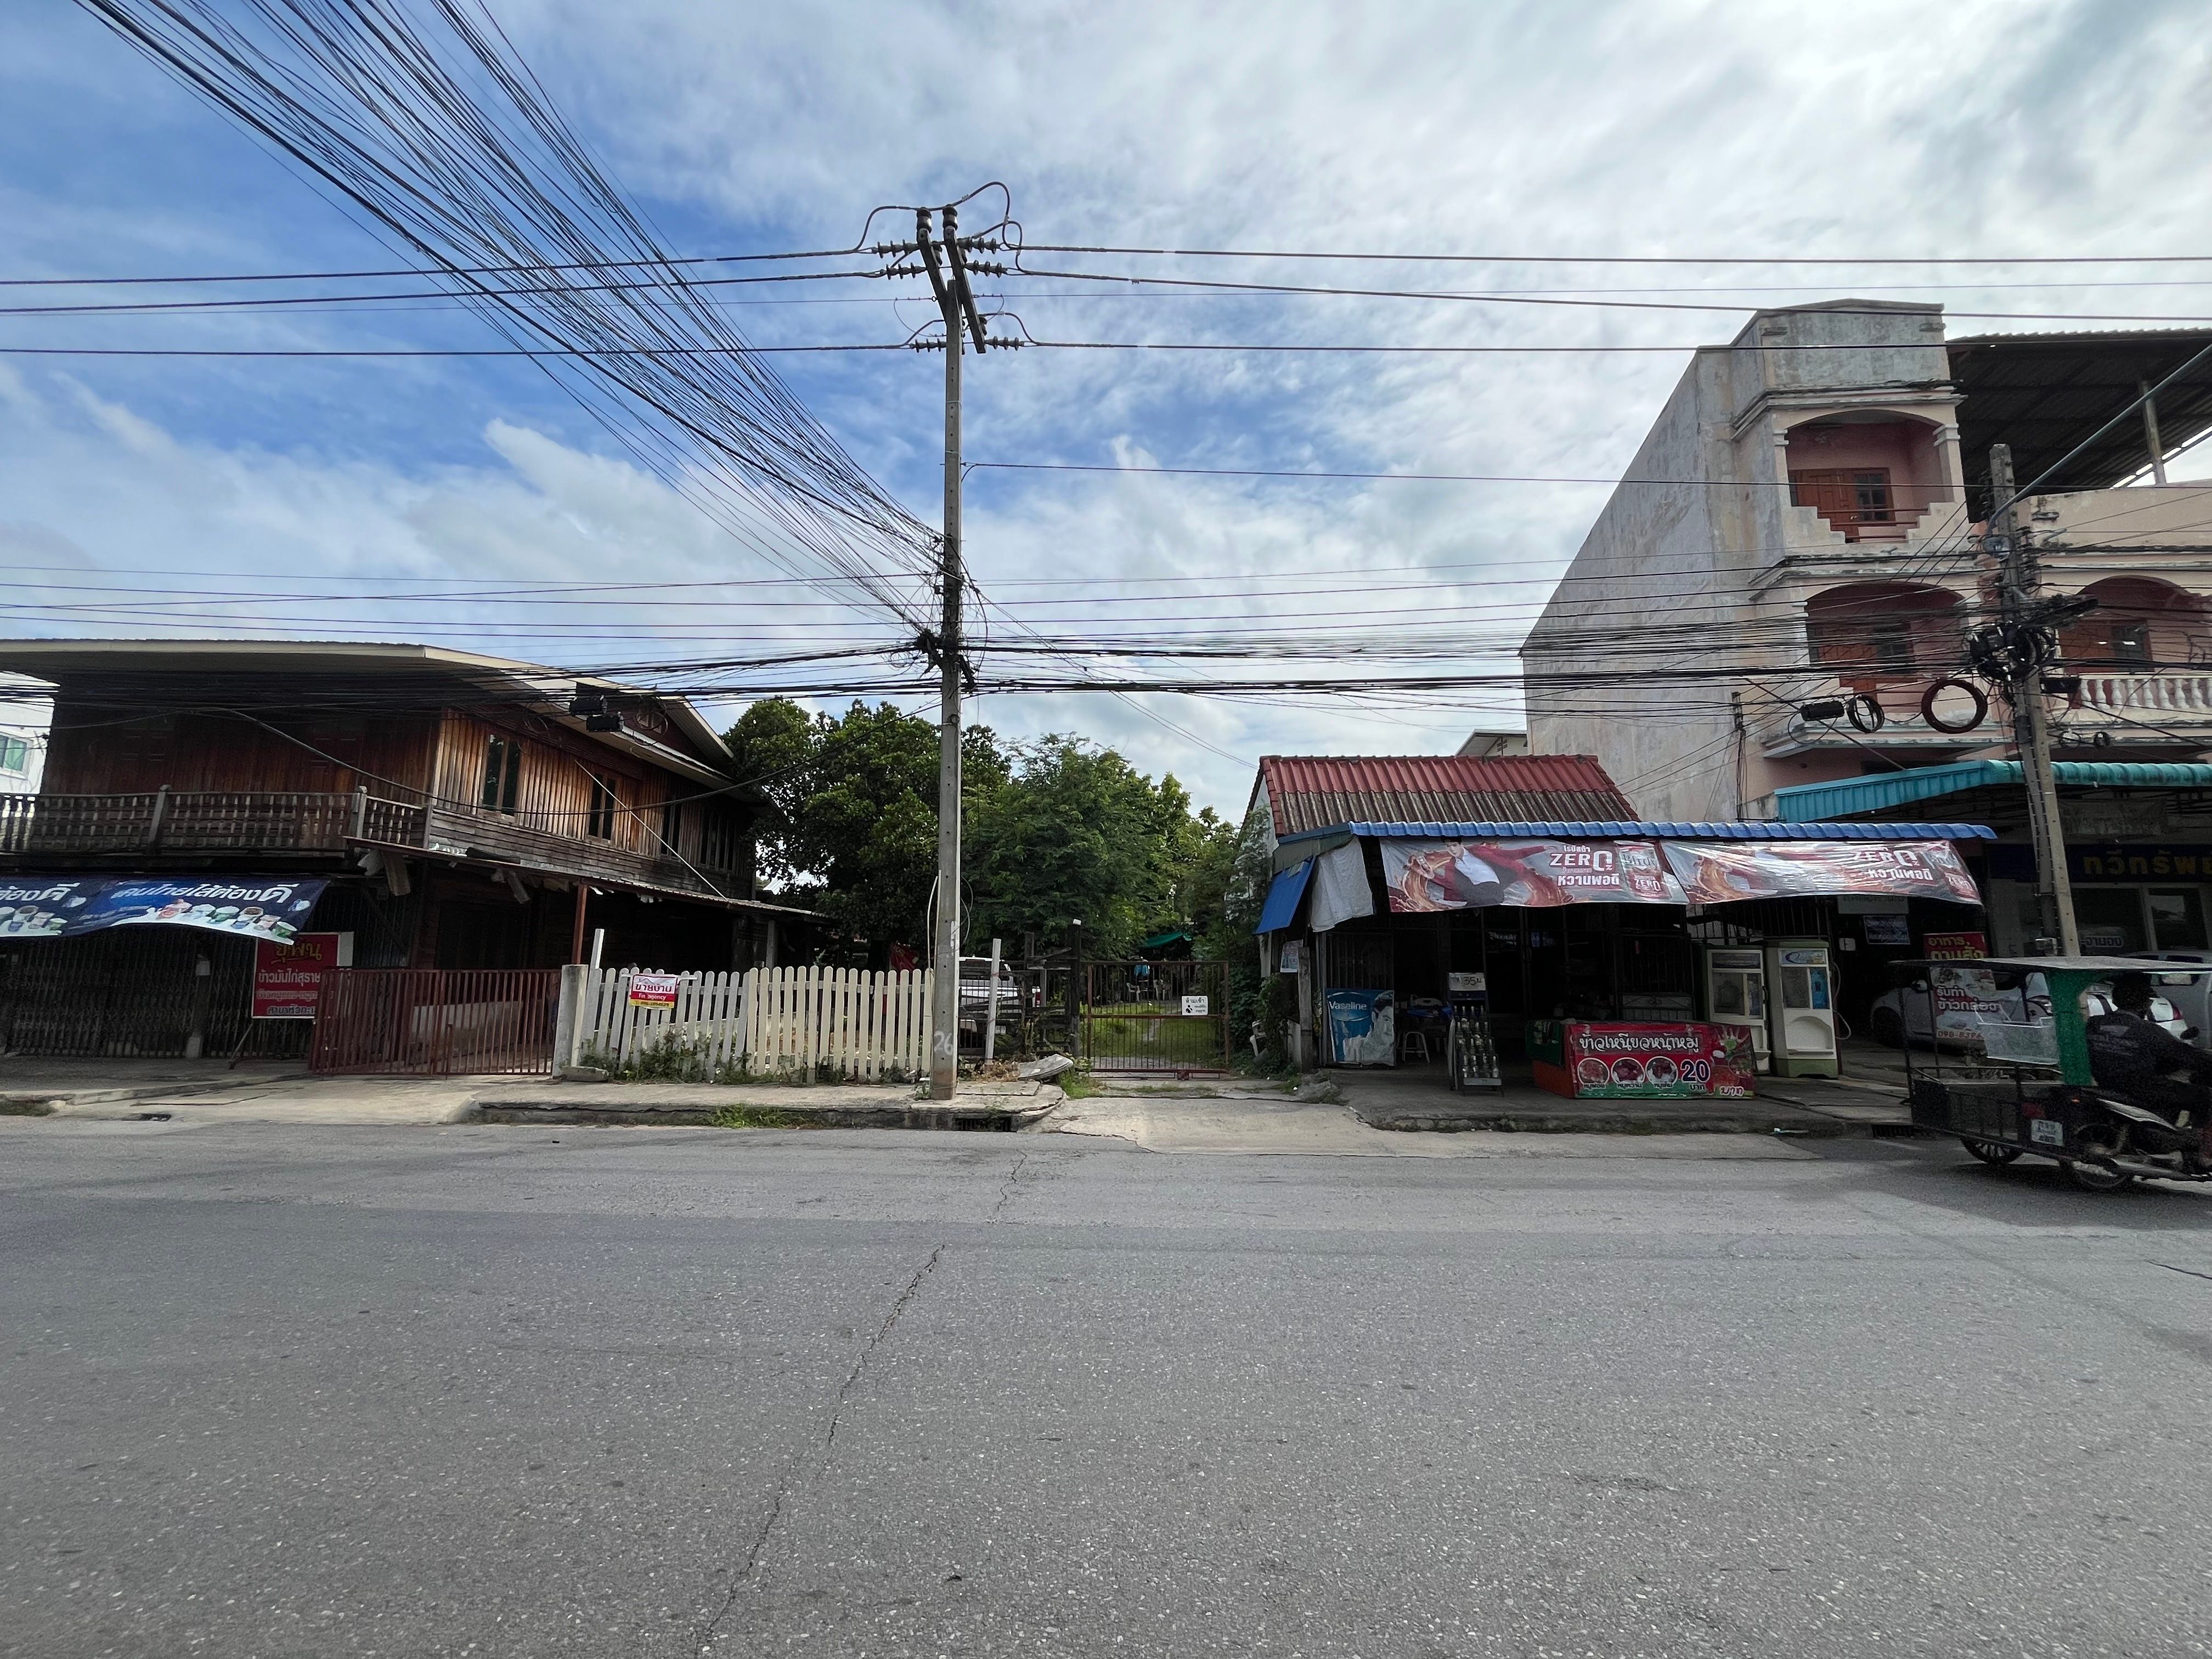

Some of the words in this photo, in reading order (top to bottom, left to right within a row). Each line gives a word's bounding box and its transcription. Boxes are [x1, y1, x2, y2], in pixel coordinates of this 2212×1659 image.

[1558, 873, 1620, 886] หวานพอดี
[635, 983, 672, 992] ขายบ้าน
[1936, 986, 1965, 996] รับทำ
[1329, 1001, 1368, 1011] Vaseline
[934, 1031, 953, 1056] 26
[1579, 1032, 1699, 1053] ข้าวเหนียวหน้าหมู
[1680, 1059, 1711, 1083] 20
